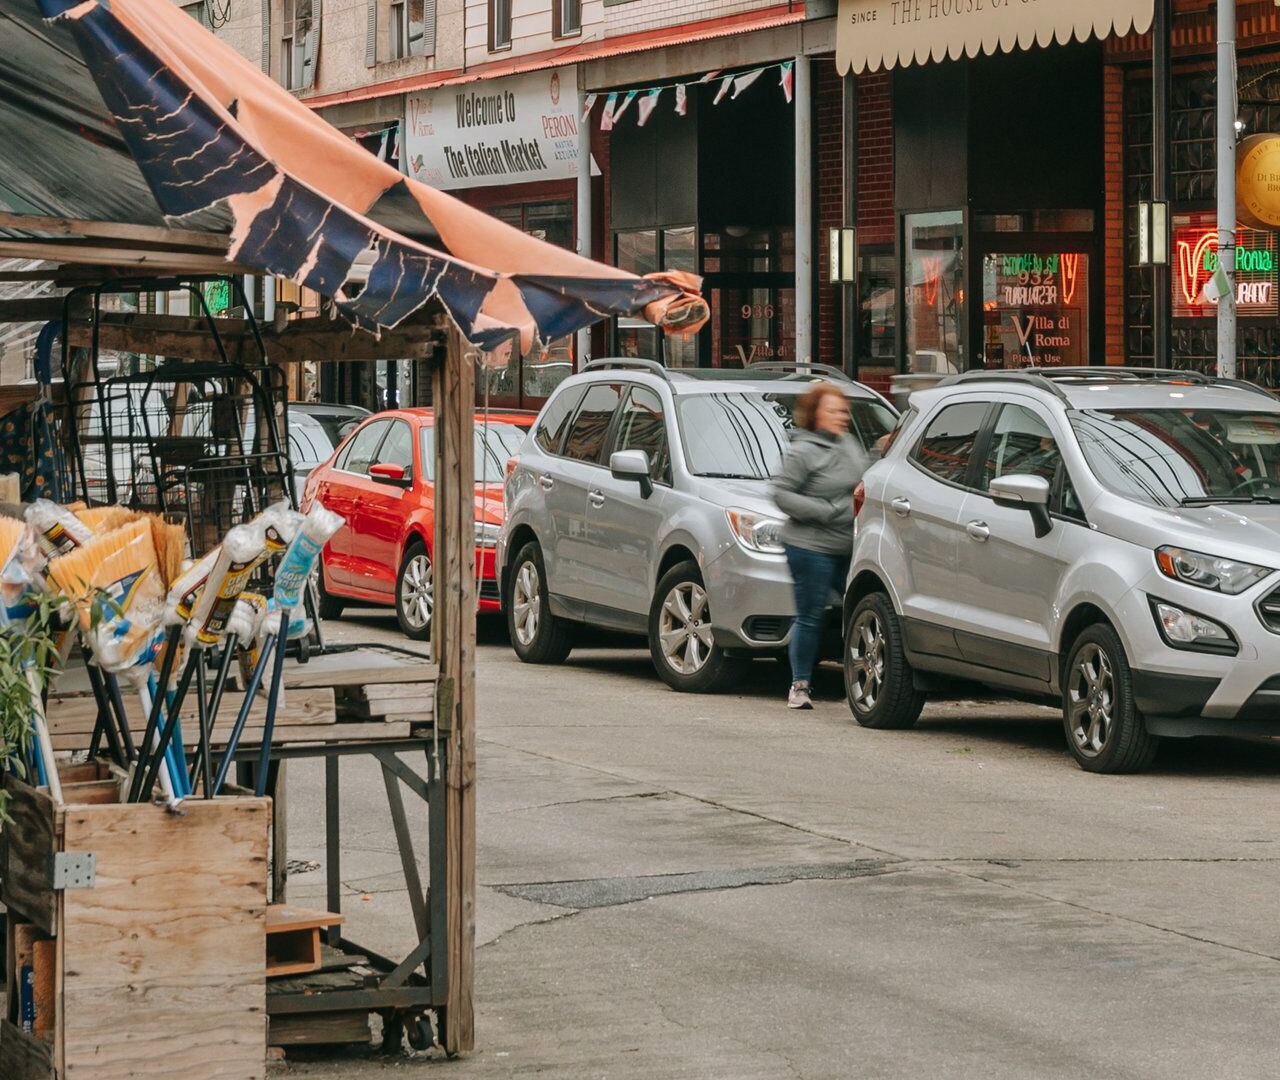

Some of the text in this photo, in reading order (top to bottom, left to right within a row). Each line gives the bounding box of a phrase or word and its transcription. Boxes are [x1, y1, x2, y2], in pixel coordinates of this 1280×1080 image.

[851, 9, 877, 24] SINCE
[455, 90, 516, 128] Welcome to
[541, 114, 578, 139] PERONI
[443, 146, 466, 179] The
[464, 141, 502, 178] Italian
[500, 137, 547, 176] Market
[1018, 269, 1054, 286] 932
[741, 305, 774, 319] 936
[1010, 315, 1069, 346] Villa di
[1035, 334, 1070, 347] Roma
[1044, 354, 1061, 363] Use
